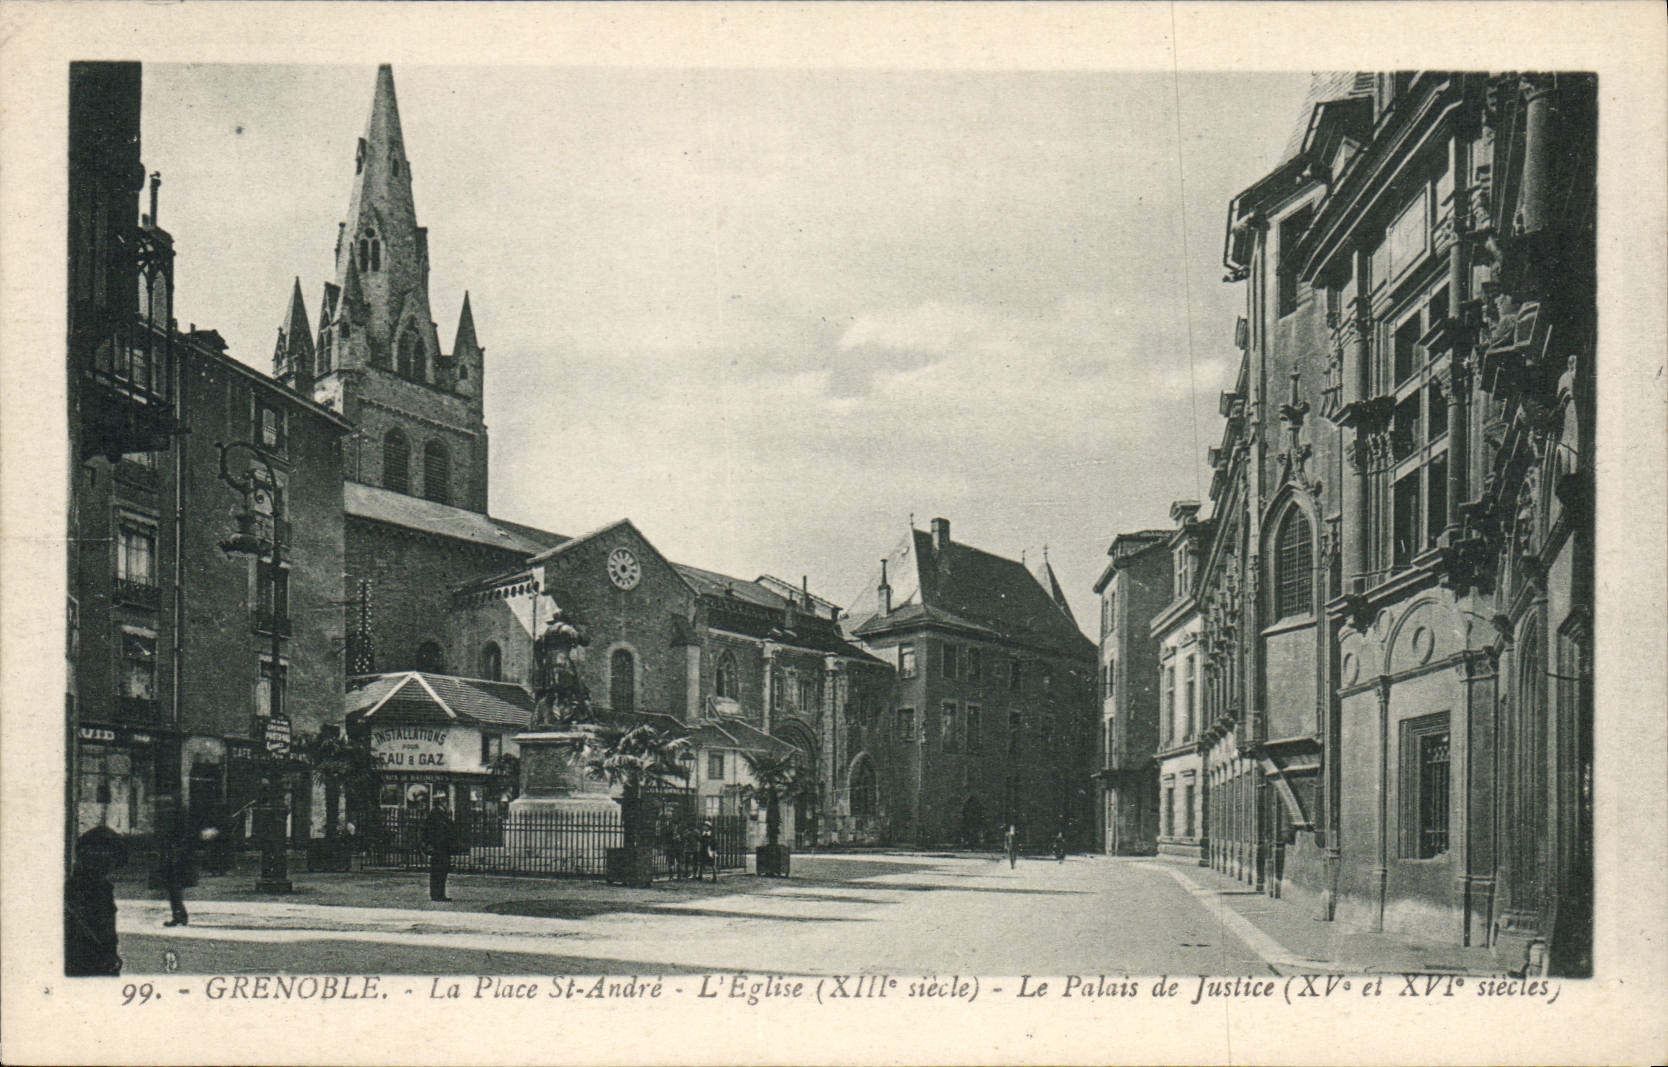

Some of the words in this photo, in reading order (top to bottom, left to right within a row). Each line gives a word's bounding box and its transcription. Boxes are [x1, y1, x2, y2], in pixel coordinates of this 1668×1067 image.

[375, 728, 447, 746] INSTALLATIONS
[379, 752, 404, 766] EAU
[418, 752, 445, 766] GAZ
